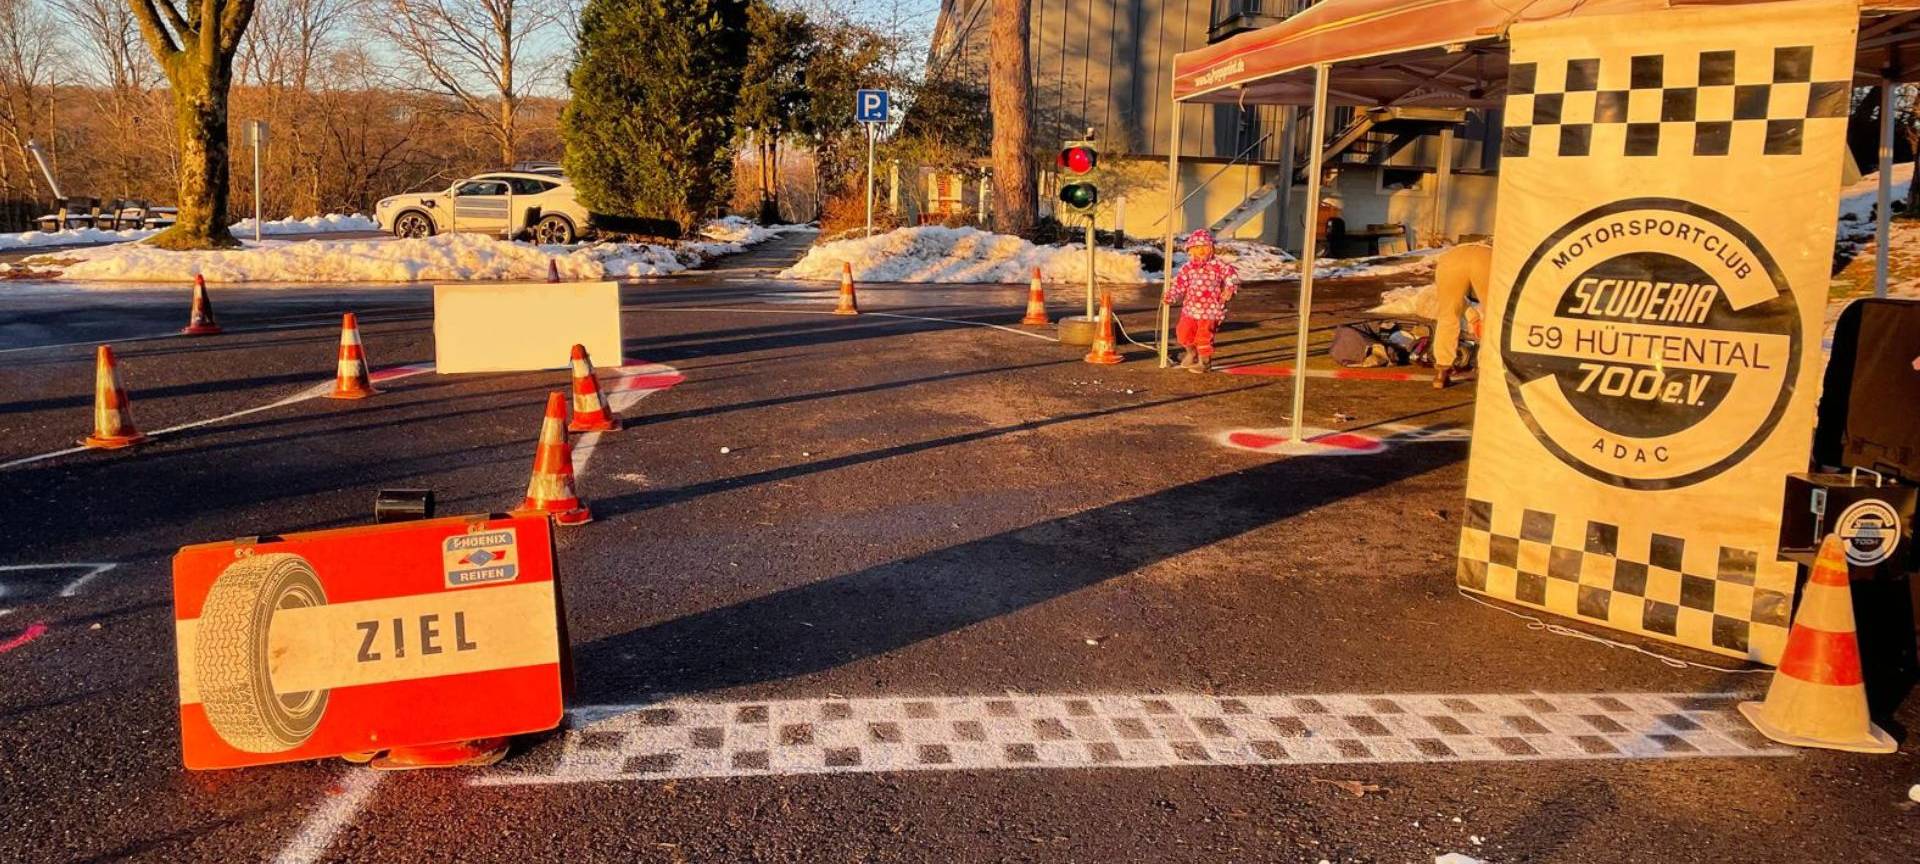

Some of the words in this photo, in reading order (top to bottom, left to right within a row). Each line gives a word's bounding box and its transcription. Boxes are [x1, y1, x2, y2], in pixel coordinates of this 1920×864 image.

[865, 94, 881, 117] P
[1551, 218, 1752, 280] MOTORSPORTCLUB
[1568, 278, 1719, 324] SCUDERIA
[1527, 325, 1563, 349] 59
[1576, 325, 1770, 370] HÜTTENTAL
[1592, 437, 1669, 463] ADAC
[453, 534, 507, 549] PHOENIX
[459, 568, 505, 582] REIFEN
[356, 611, 478, 663] ZIEL
